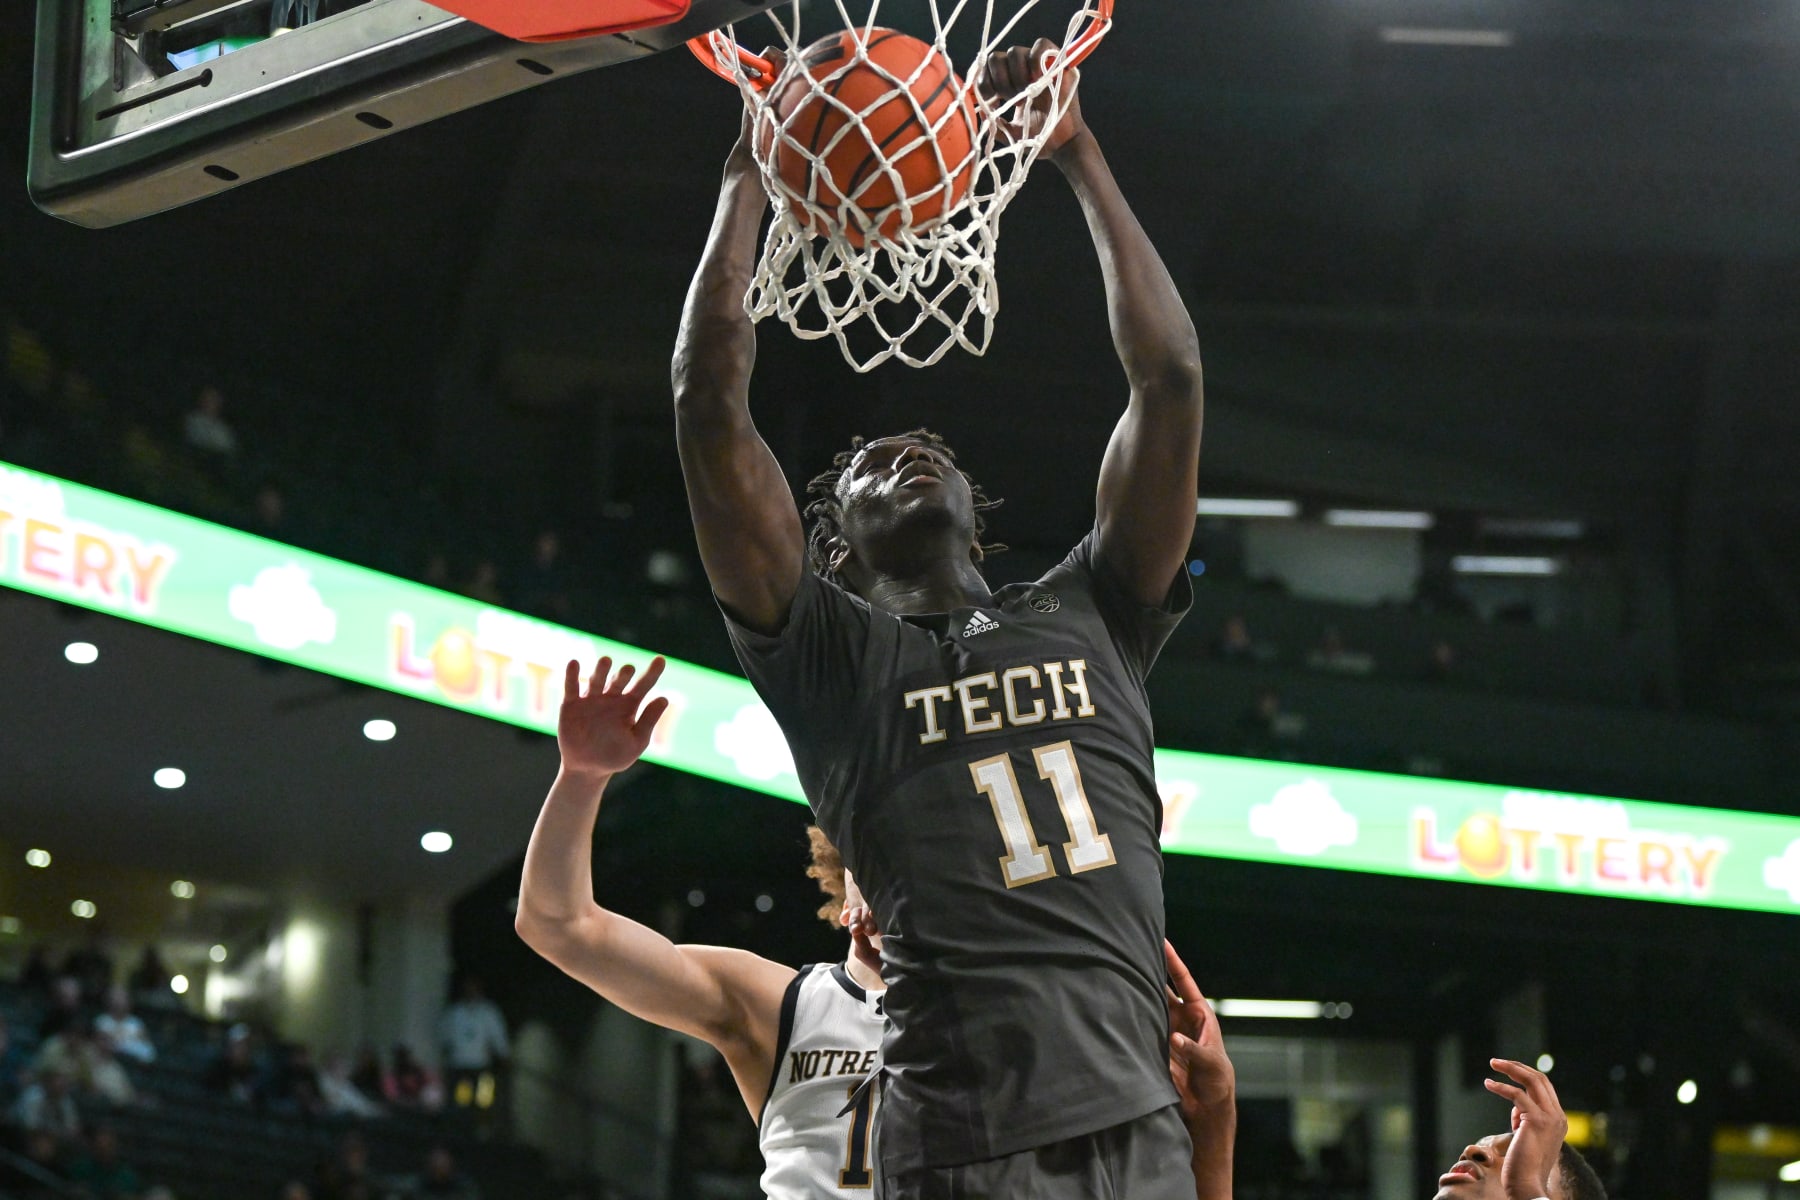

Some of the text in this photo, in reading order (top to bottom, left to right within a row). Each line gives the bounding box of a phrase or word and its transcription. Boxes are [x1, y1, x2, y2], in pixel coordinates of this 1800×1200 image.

[963, 621, 1000, 638] adidas
[904, 659, 1096, 745] TECH
[968, 740, 1117, 889] 11
[1414, 809, 1721, 889] LOTTERY
[789, 1050, 878, 1084] NOTRE
